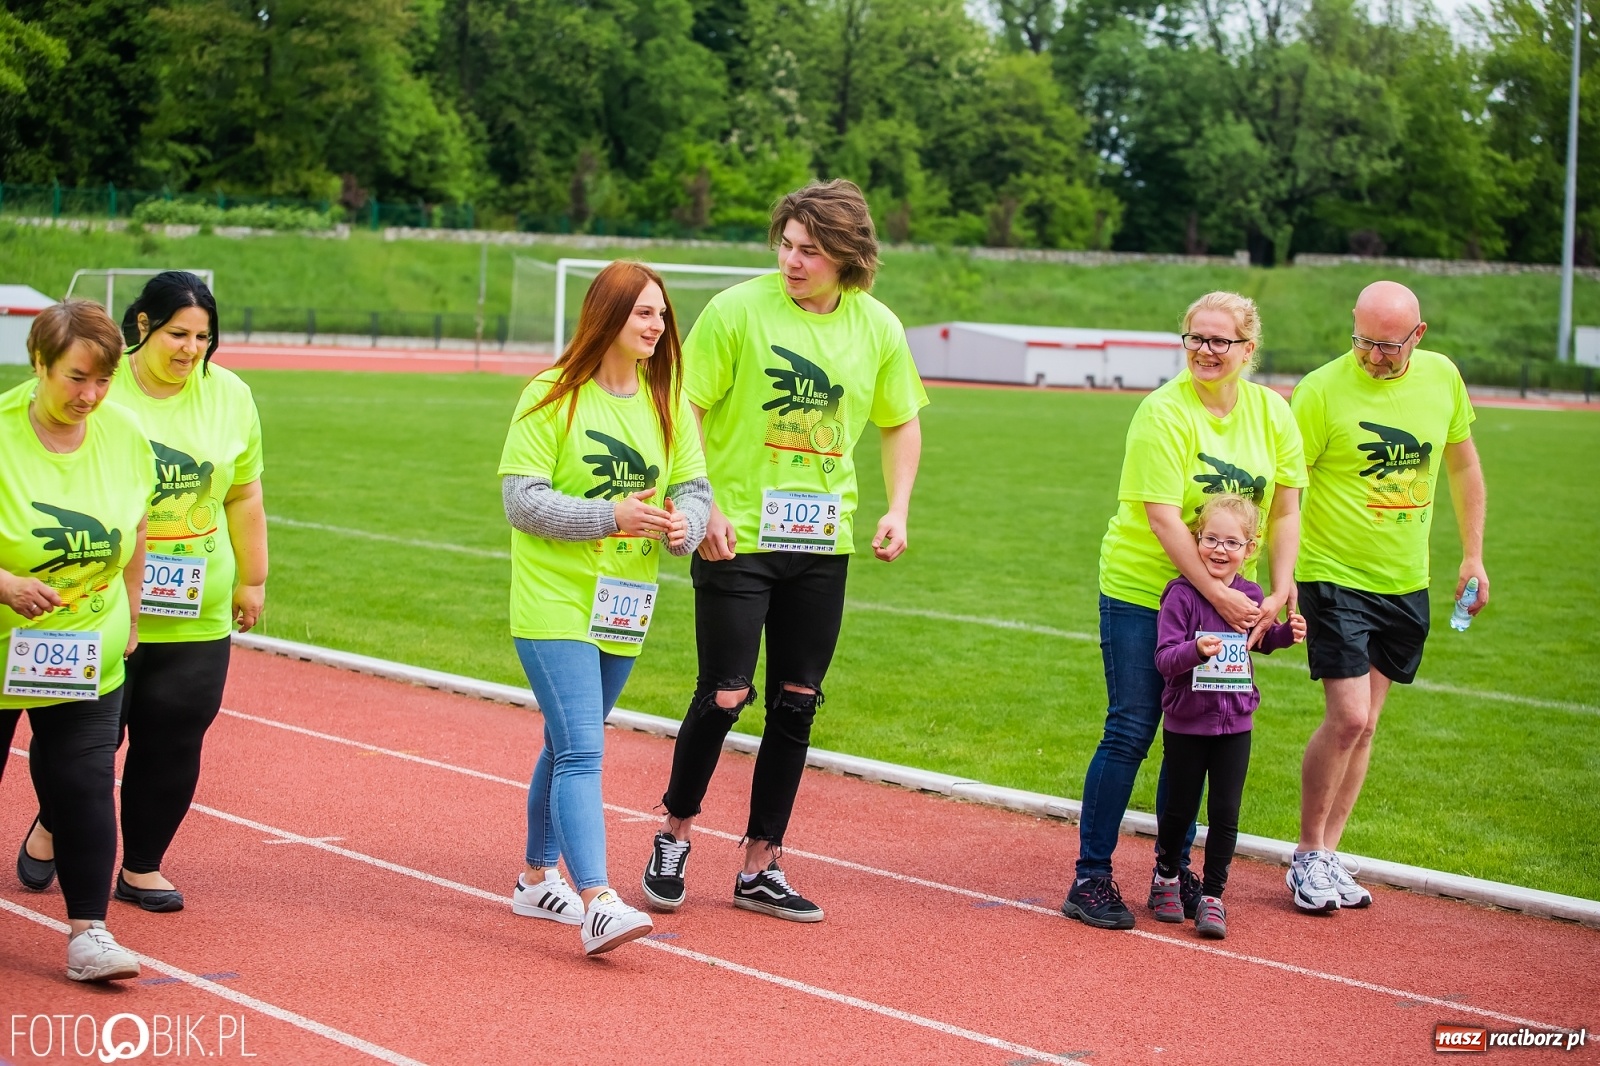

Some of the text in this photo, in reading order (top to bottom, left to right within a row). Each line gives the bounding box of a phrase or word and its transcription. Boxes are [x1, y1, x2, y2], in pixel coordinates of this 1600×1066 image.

[794, 377, 828, 400] VI BIEG
[792, 395, 829, 407] BEZ BARIER
[1385, 444, 1420, 461] VI BIEG
[612, 460, 645, 481] VI BIEG
[1398, 458, 1421, 466] BARIER
[160, 464, 199, 482] VI BIEG
[162, 480, 201, 490] BEZ BARIER
[1221, 478, 1239, 494] VI
[783, 502, 821, 524] 102
[827, 505, 836, 516] R
[64, 530, 110, 552] VI BIEG
[67, 549, 112, 560] BEZ BARIER
[143, 564, 184, 588] 004
[191, 568, 201, 579] R
[609, 594, 639, 618] 101
[645, 593, 652, 605] R
[34, 642, 80, 666] 084
[87, 644, 96, 656] R
[1216, 643, 1246, 663] 086
